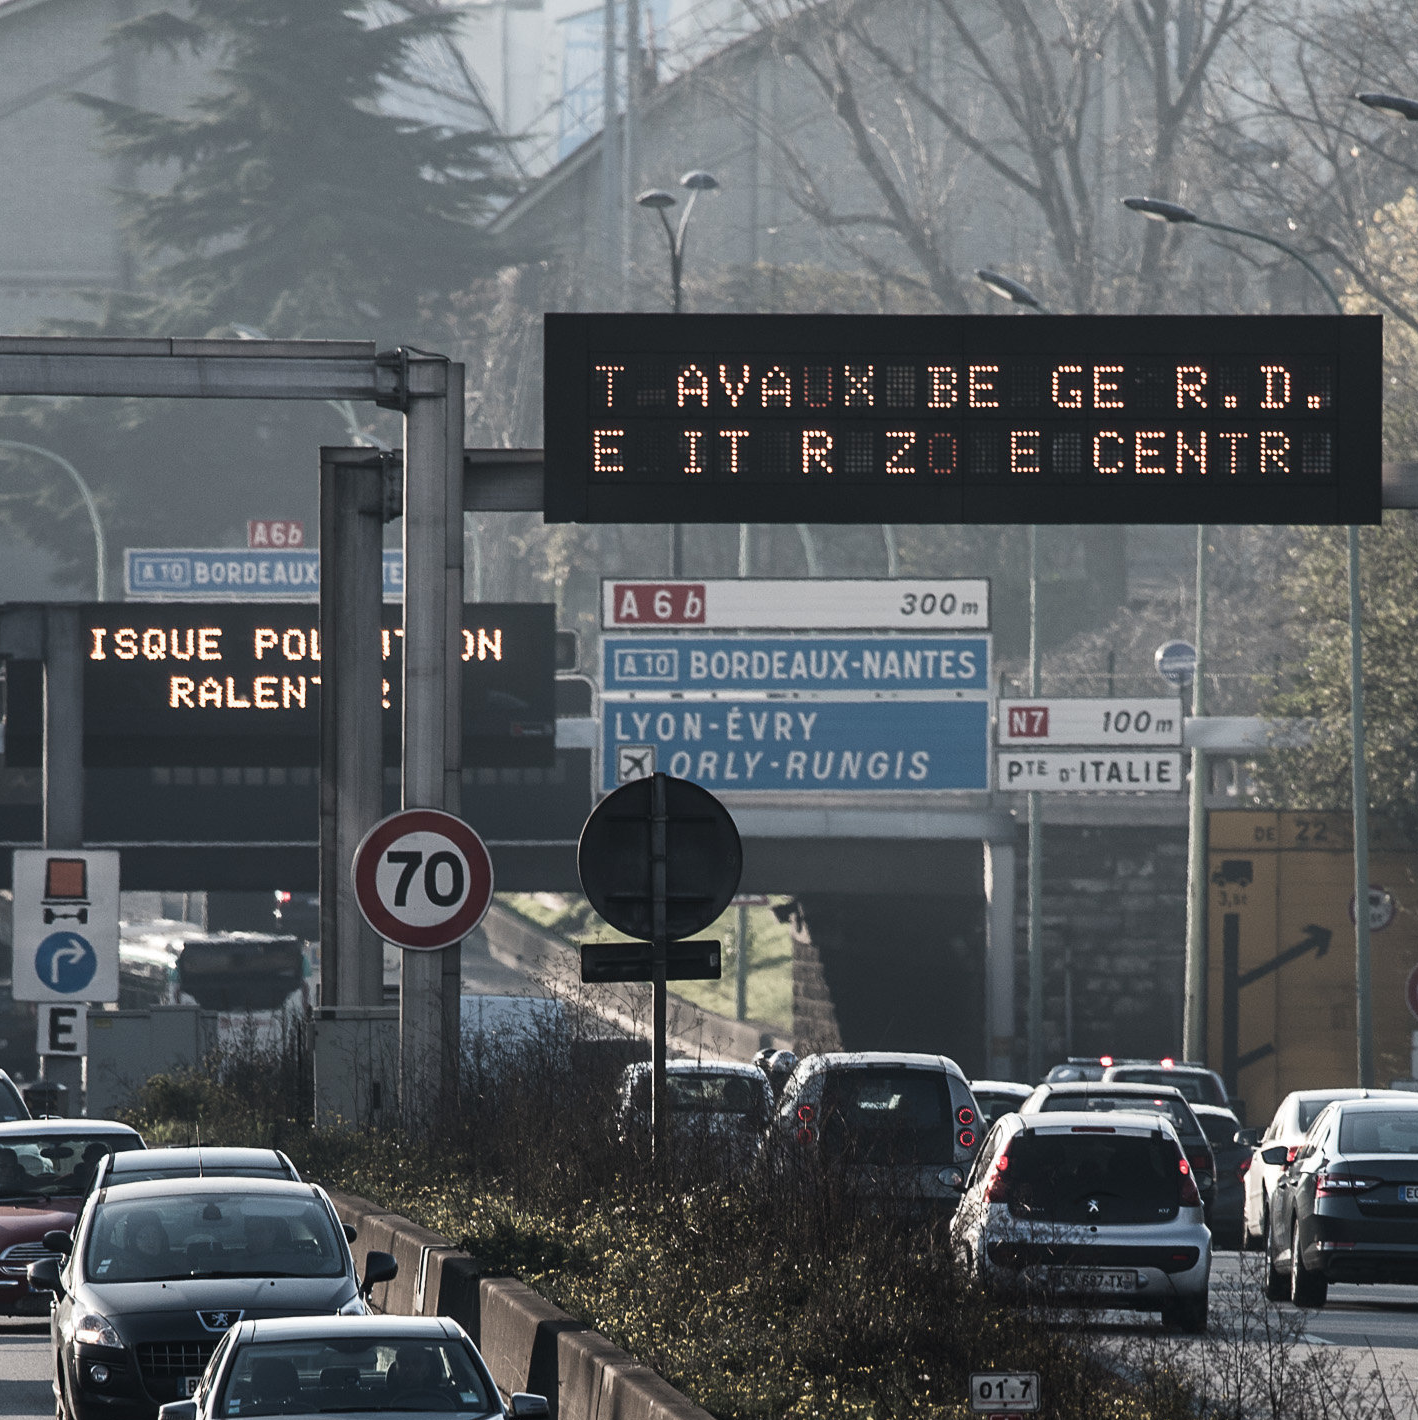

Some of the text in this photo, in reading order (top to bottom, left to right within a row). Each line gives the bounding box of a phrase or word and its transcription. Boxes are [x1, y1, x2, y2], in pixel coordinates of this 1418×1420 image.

[594, 363, 626, 408] T
[253, 521, 303, 547] A6b
[689, 649, 977, 680] BORDEAUX-NANTES
[1011, 710, 1044, 734] N7
[386, 850, 465, 908] 70
[49, 1008, 78, 1052] E
